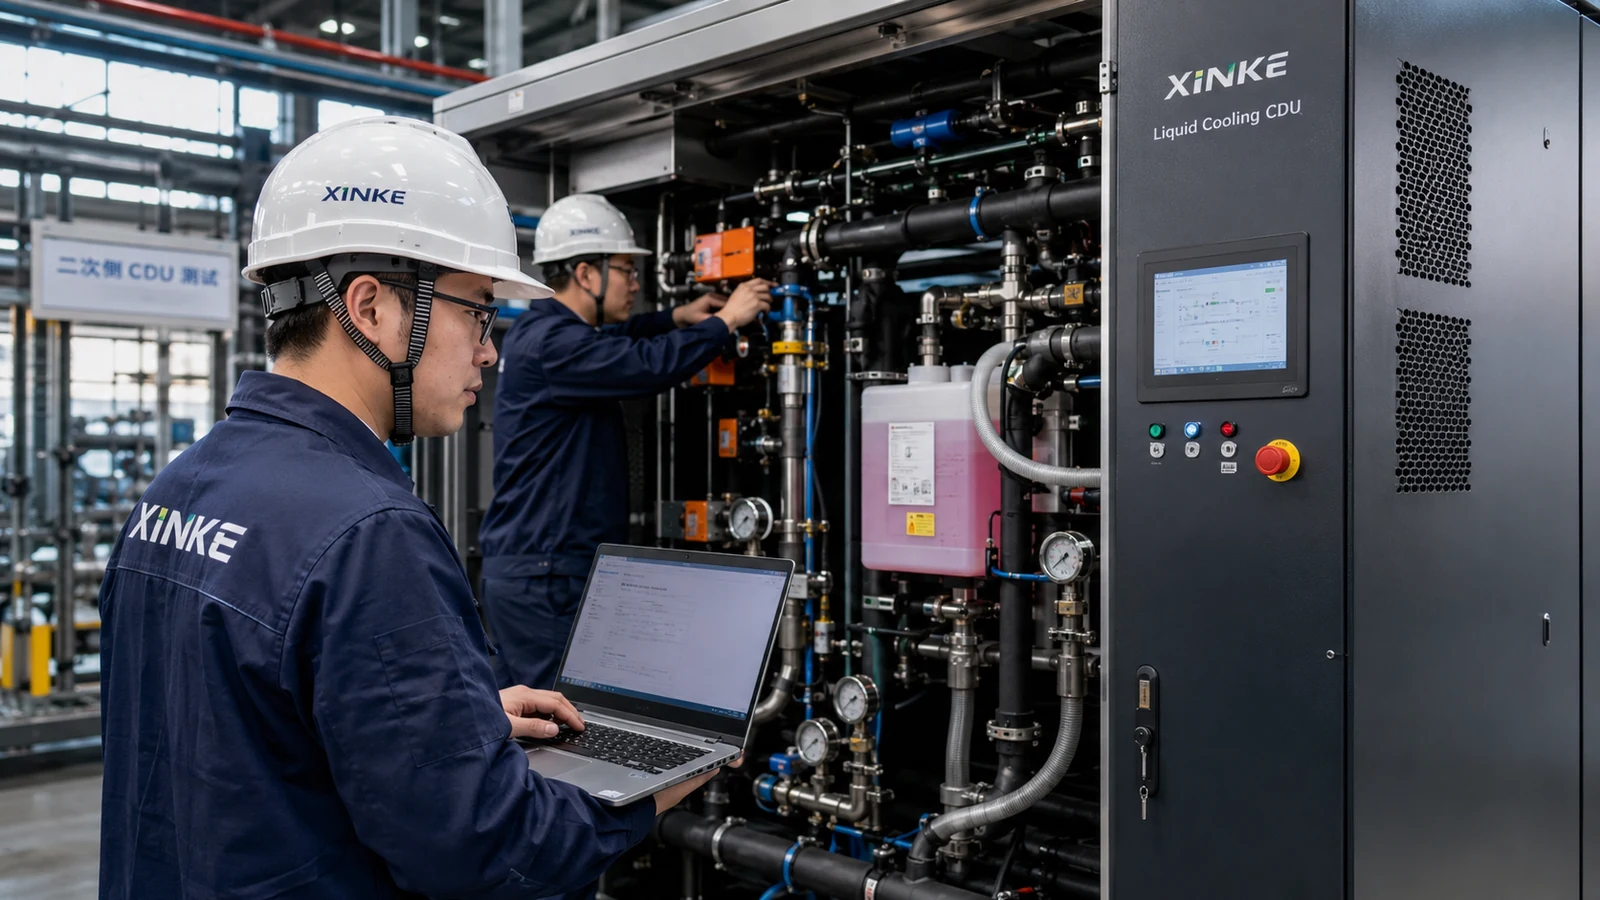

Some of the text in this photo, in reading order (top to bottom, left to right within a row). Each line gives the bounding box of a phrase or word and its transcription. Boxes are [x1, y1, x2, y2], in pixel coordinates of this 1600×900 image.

[1153, 99, 1301, 141] Liquid Cooling CDU
[321, 186, 406, 205] XINKE
[128, 263, 174, 283] CDU
[128, 502, 248, 563] XINKE
